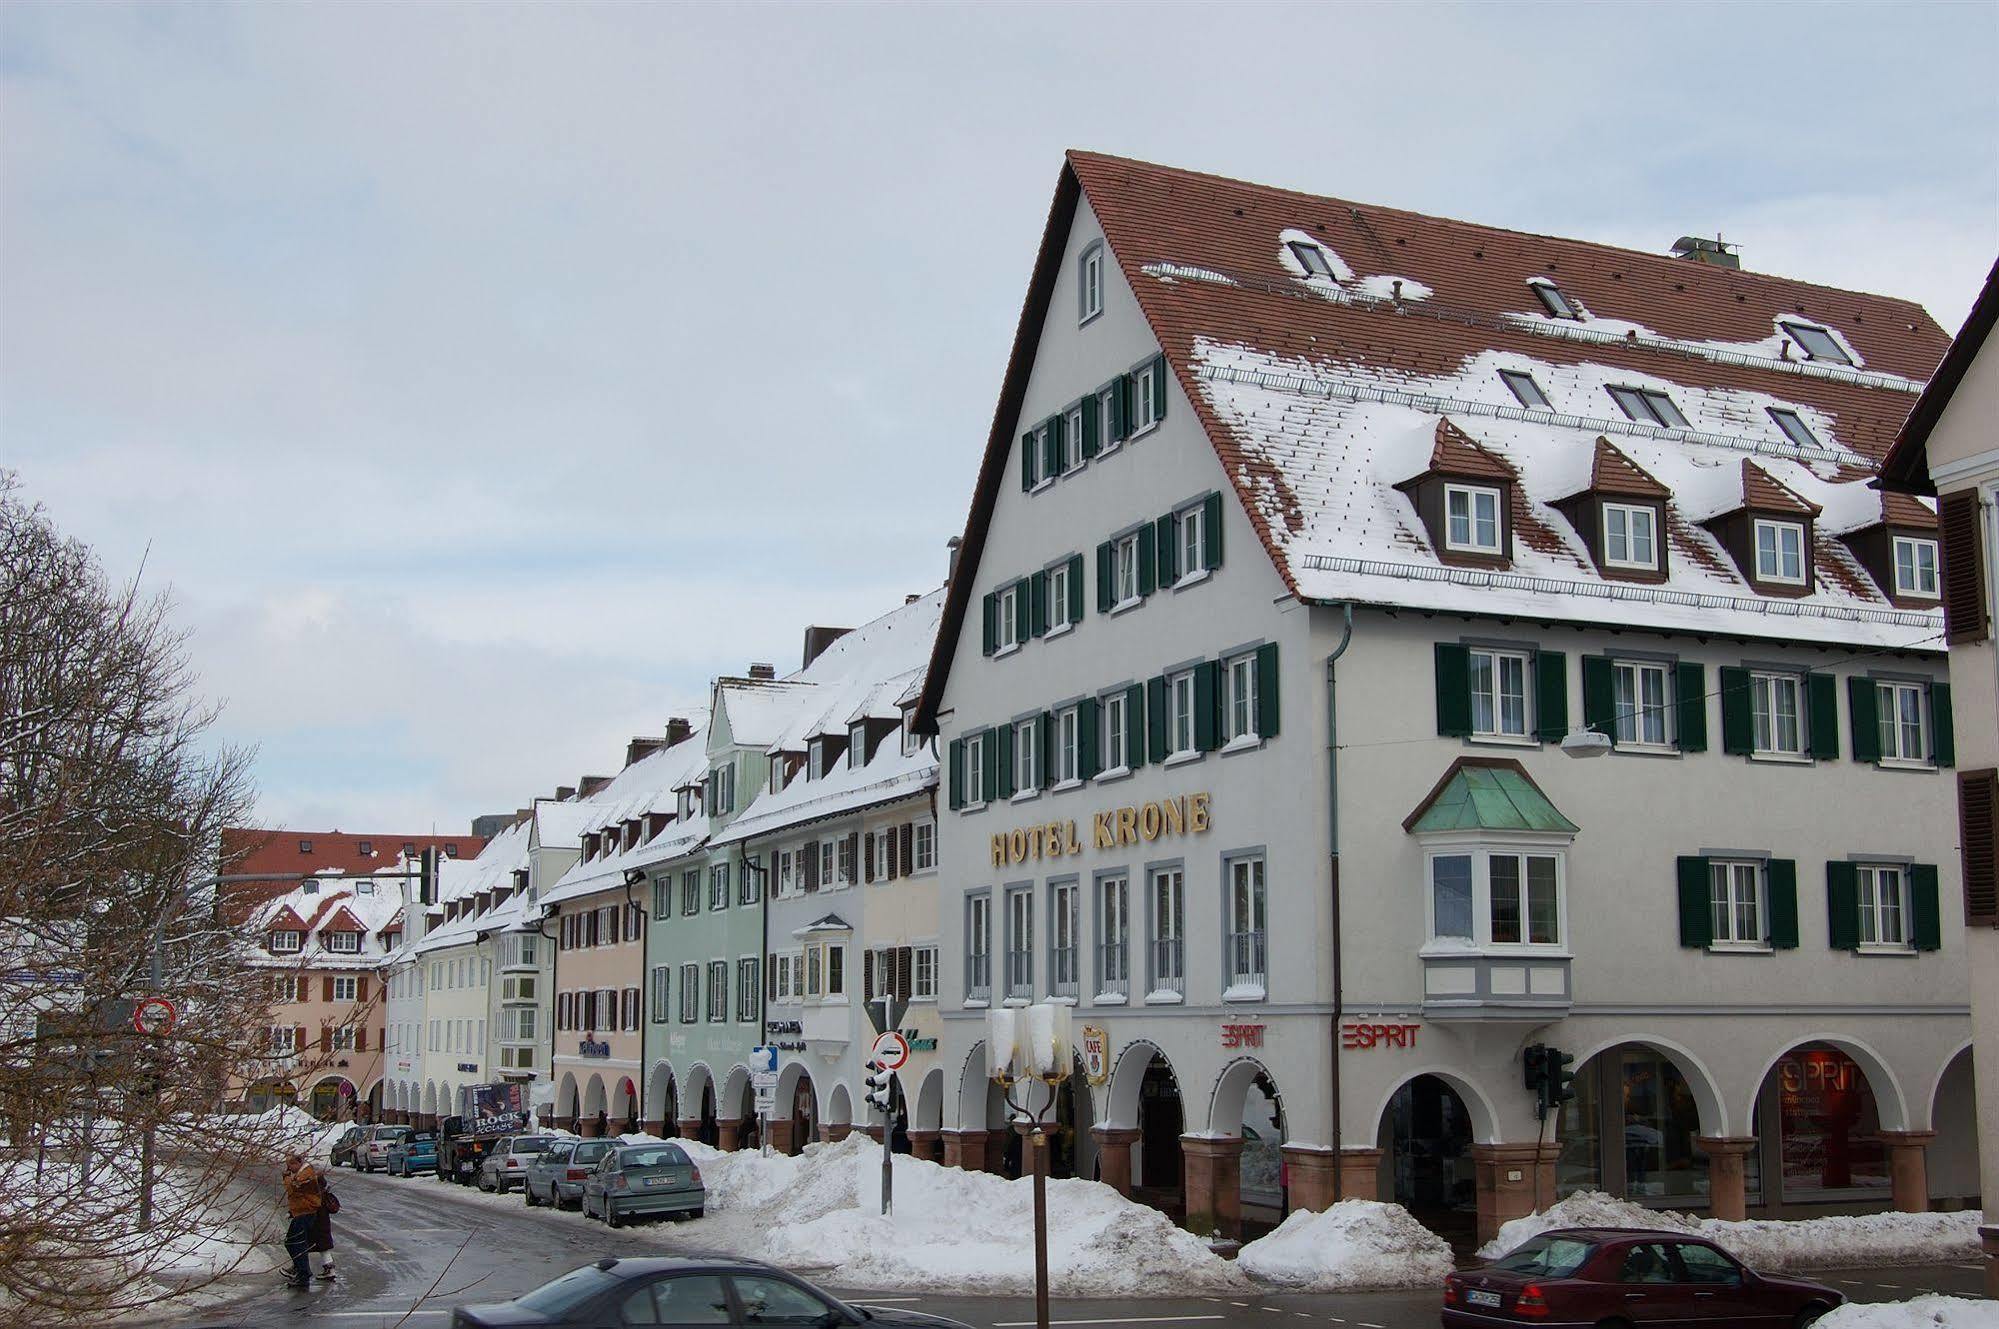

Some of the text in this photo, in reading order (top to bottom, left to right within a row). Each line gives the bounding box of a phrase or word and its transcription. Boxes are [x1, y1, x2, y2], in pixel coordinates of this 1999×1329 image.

[991, 791, 1212, 868] HOTEL KRONE
[1221, 1024, 1267, 1049] ESPRIT
[1342, 1024, 1421, 1049] ESPRIT
[1780, 1060, 1858, 1093] SPRIT
[475, 1111, 521, 1127] ROCK
[475, 1121, 514, 1134] HOUSE
